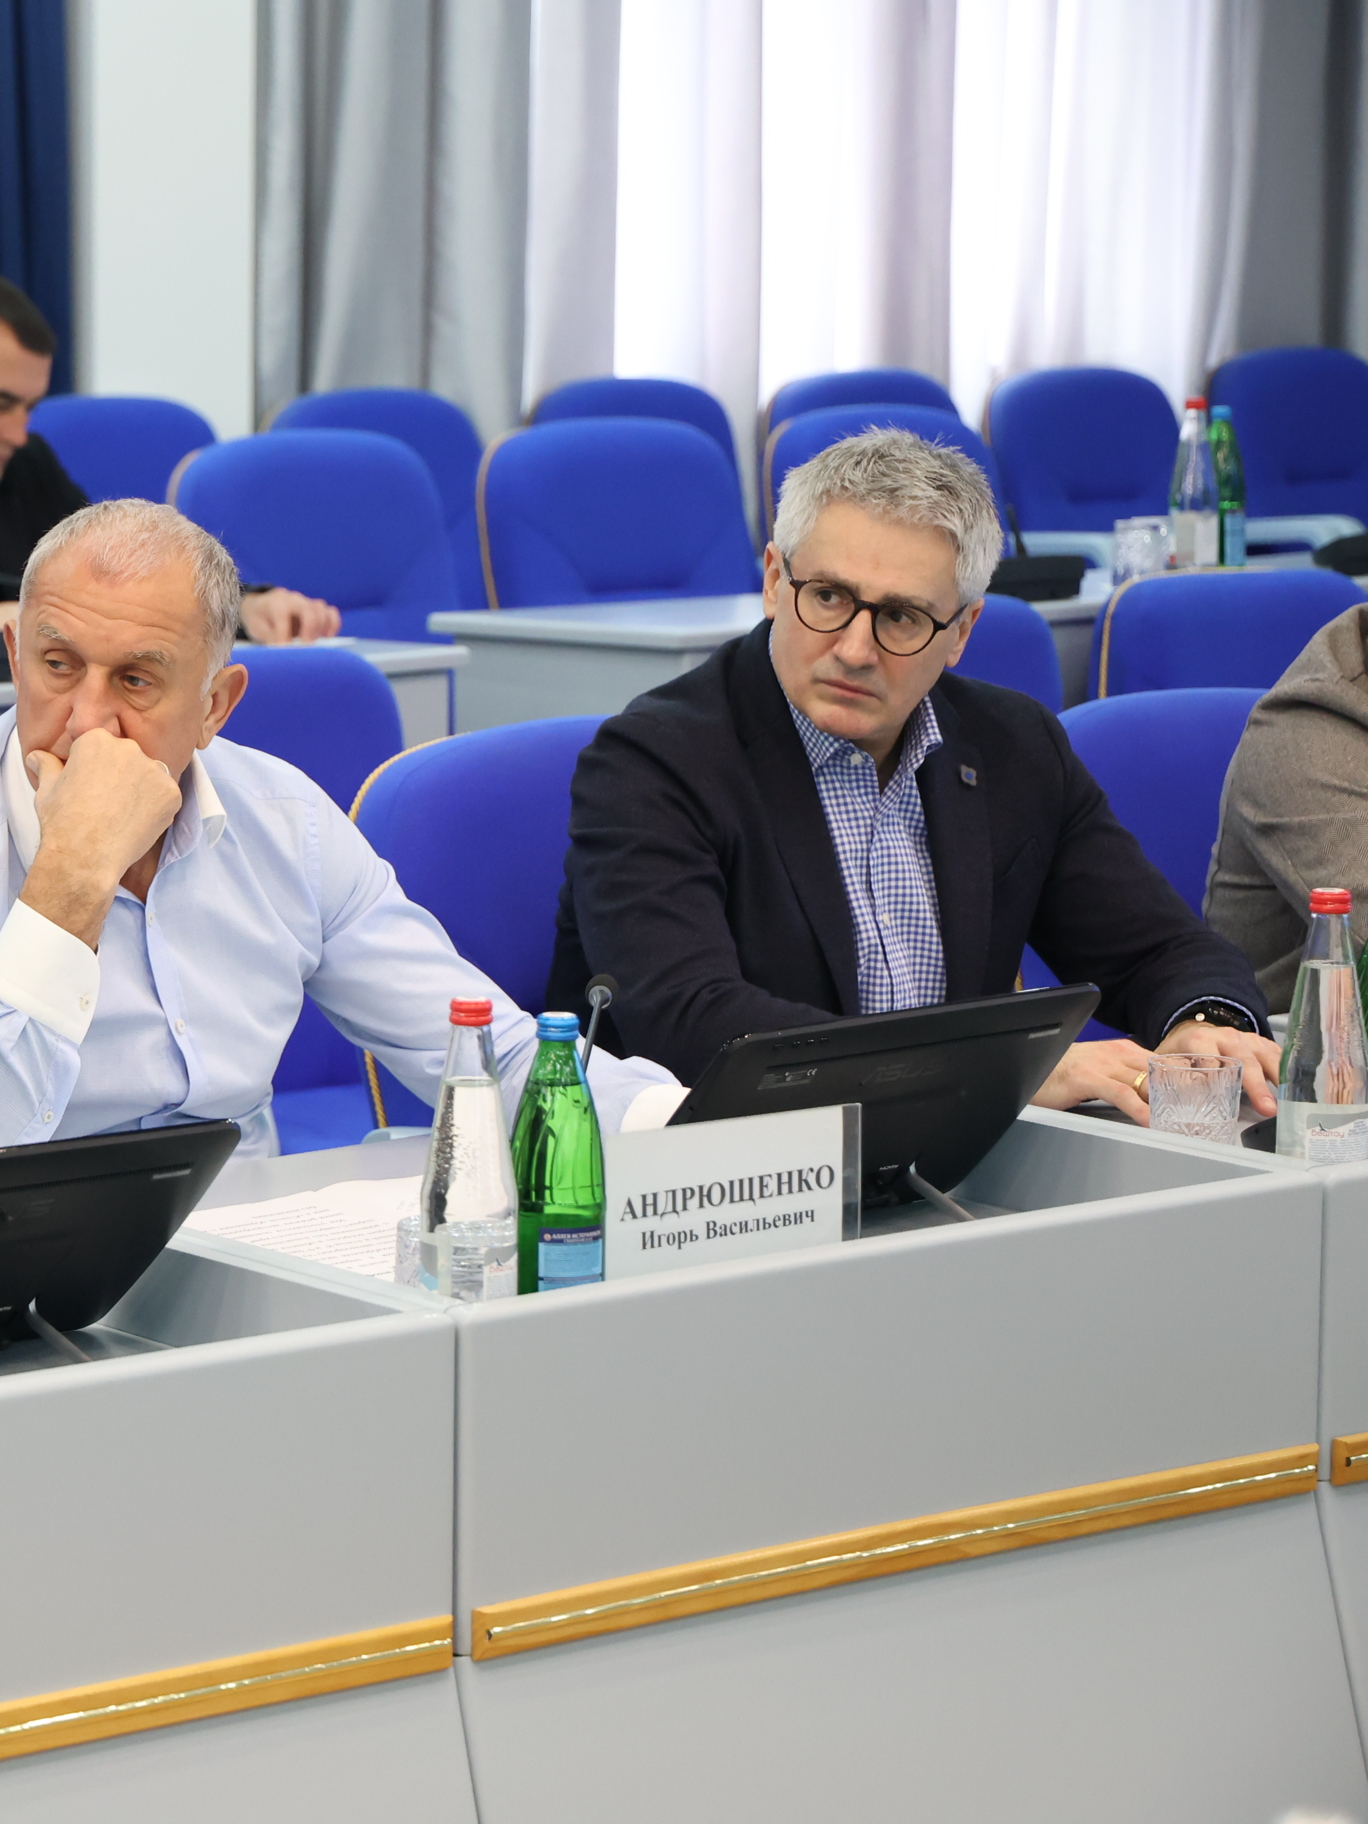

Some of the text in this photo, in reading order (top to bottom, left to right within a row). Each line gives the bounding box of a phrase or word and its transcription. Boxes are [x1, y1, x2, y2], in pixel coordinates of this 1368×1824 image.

[620, 1165, 835, 1222] АНДРЮЩЕНКО
[641, 1209, 815, 1250] Игорь Васильевич
